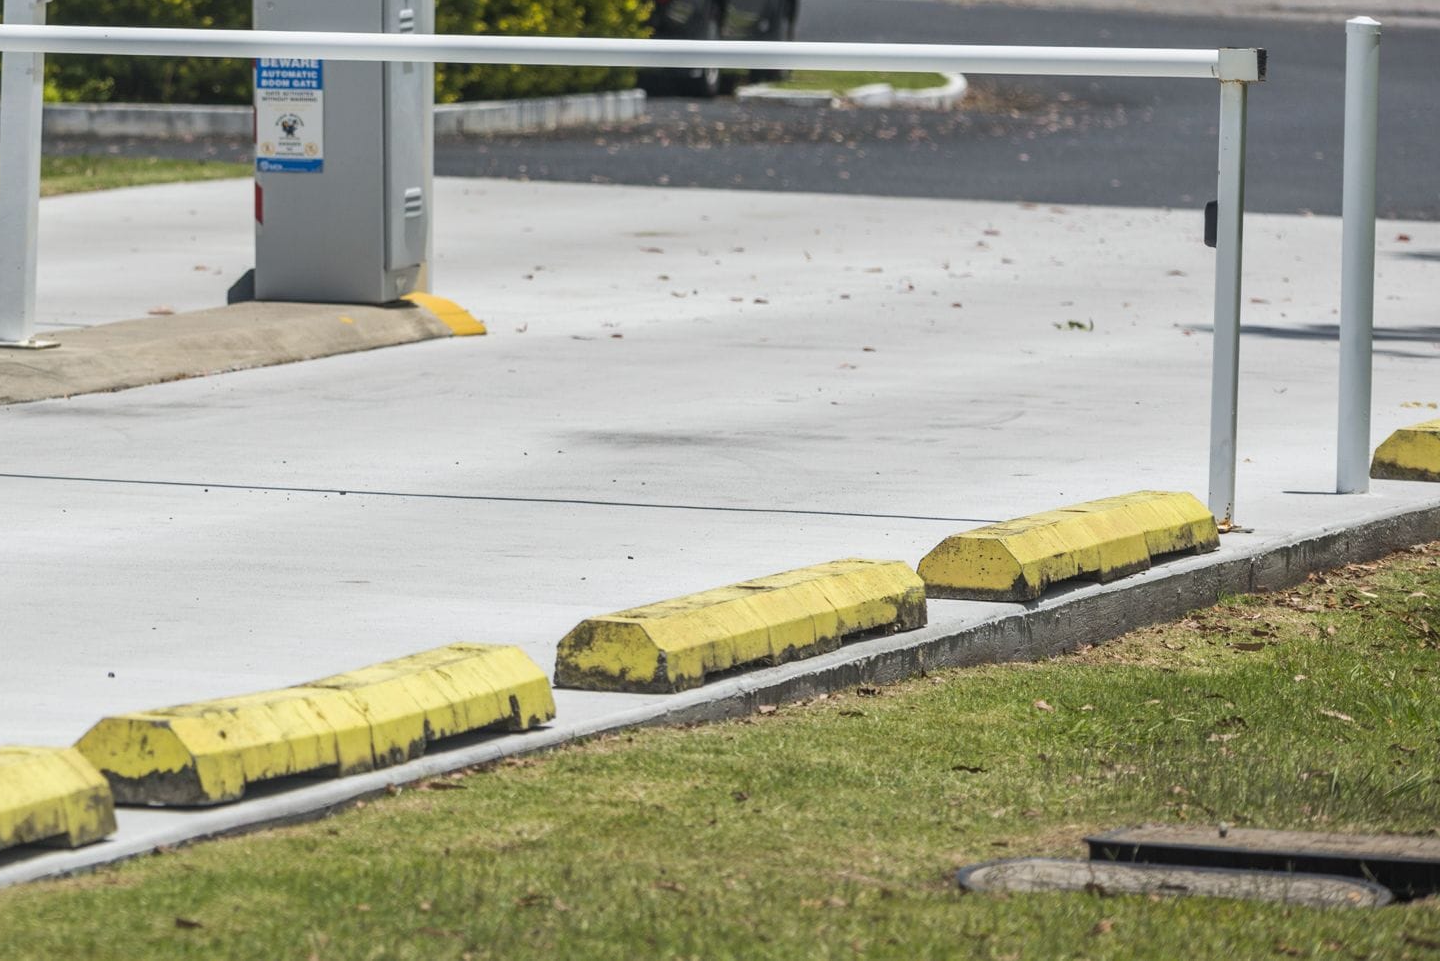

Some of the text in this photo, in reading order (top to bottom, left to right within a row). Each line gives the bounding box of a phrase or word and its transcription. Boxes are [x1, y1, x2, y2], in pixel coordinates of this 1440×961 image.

[260, 58, 320, 68] BEWARE
[261, 70, 318, 78] AUTOMATIC
[261, 79, 318, 88] BOOM GATE
